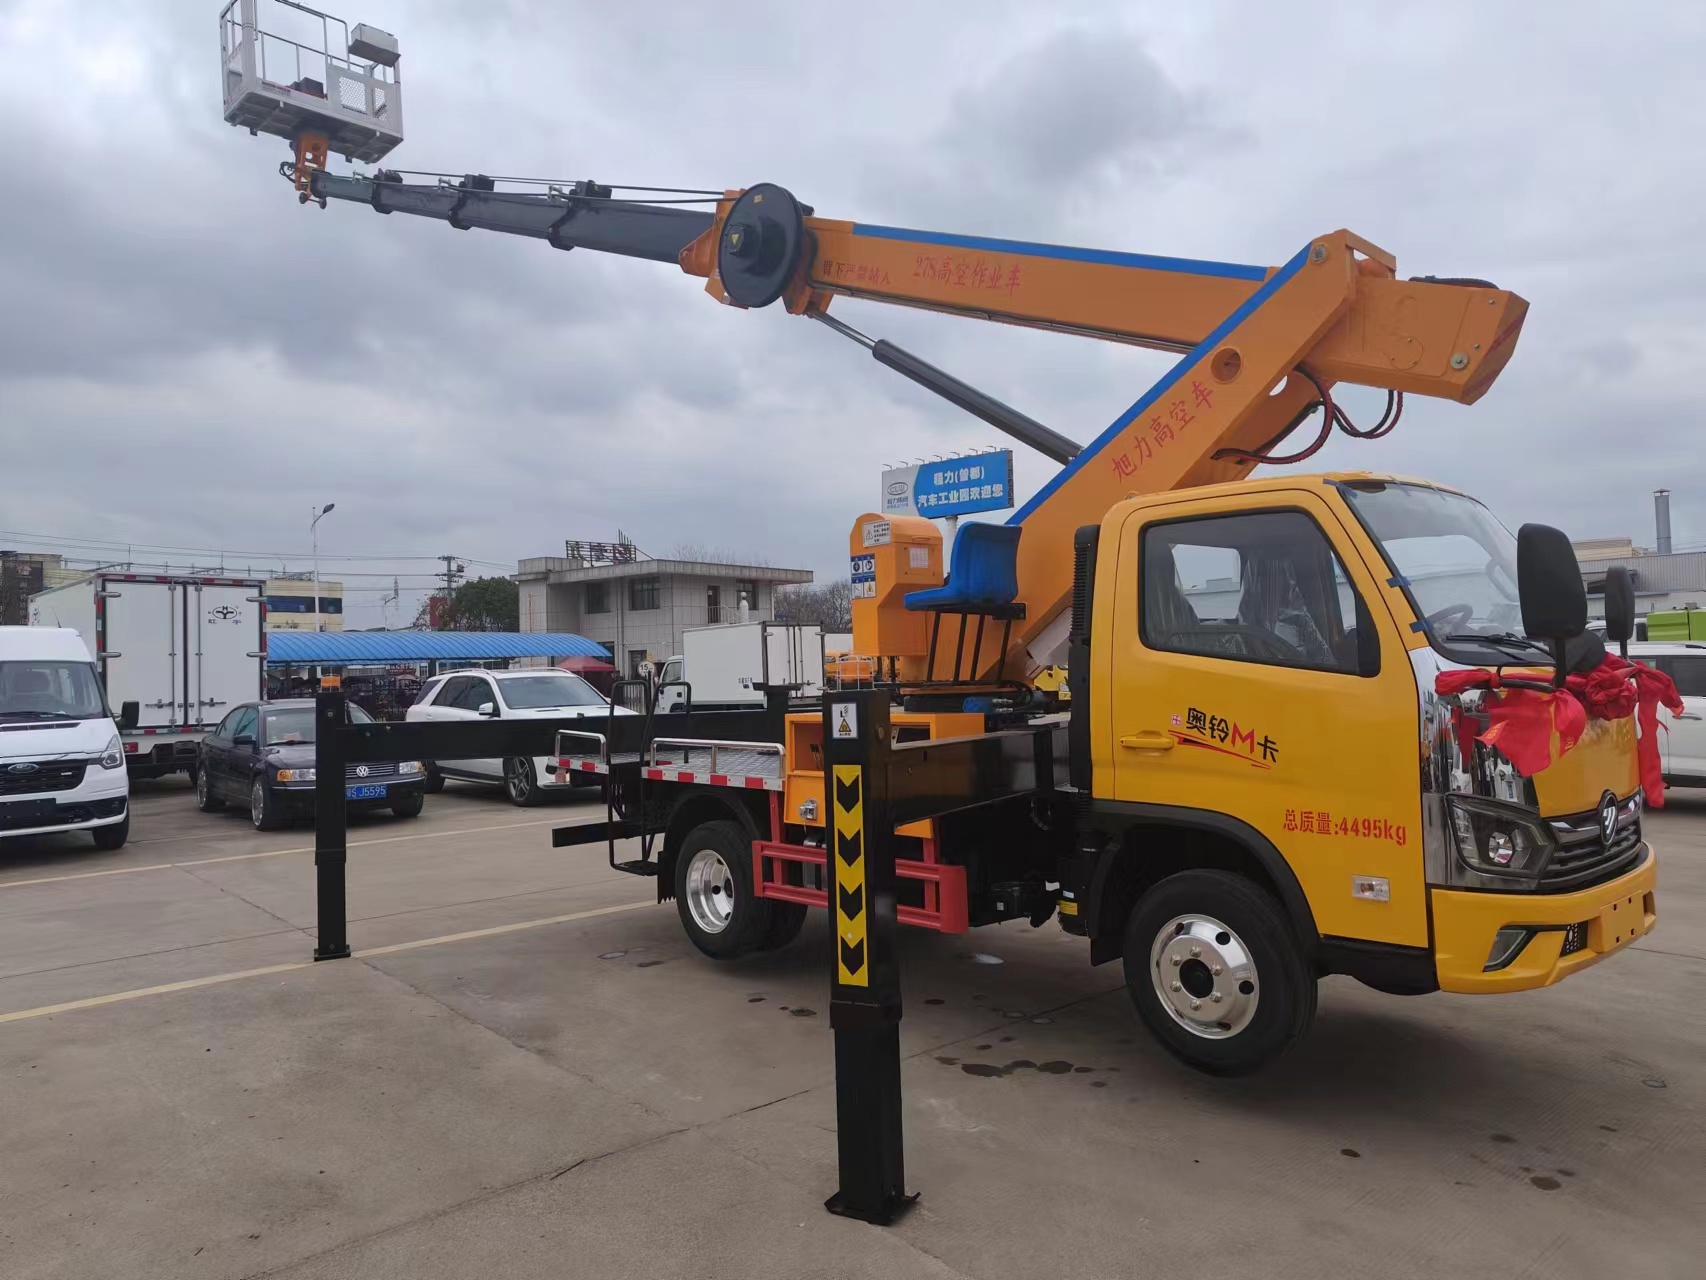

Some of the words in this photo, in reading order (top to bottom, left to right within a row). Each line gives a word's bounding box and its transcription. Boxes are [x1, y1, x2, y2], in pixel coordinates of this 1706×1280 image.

[1111, 380, 1214, 484] 旭力高空车
[917, 483, 1004, 508] 汽车工业园欢迎您
[1186, 707, 1279, 763] 奥铃M卡
[1283, 808, 1407, 846] 总质量:4495kg
